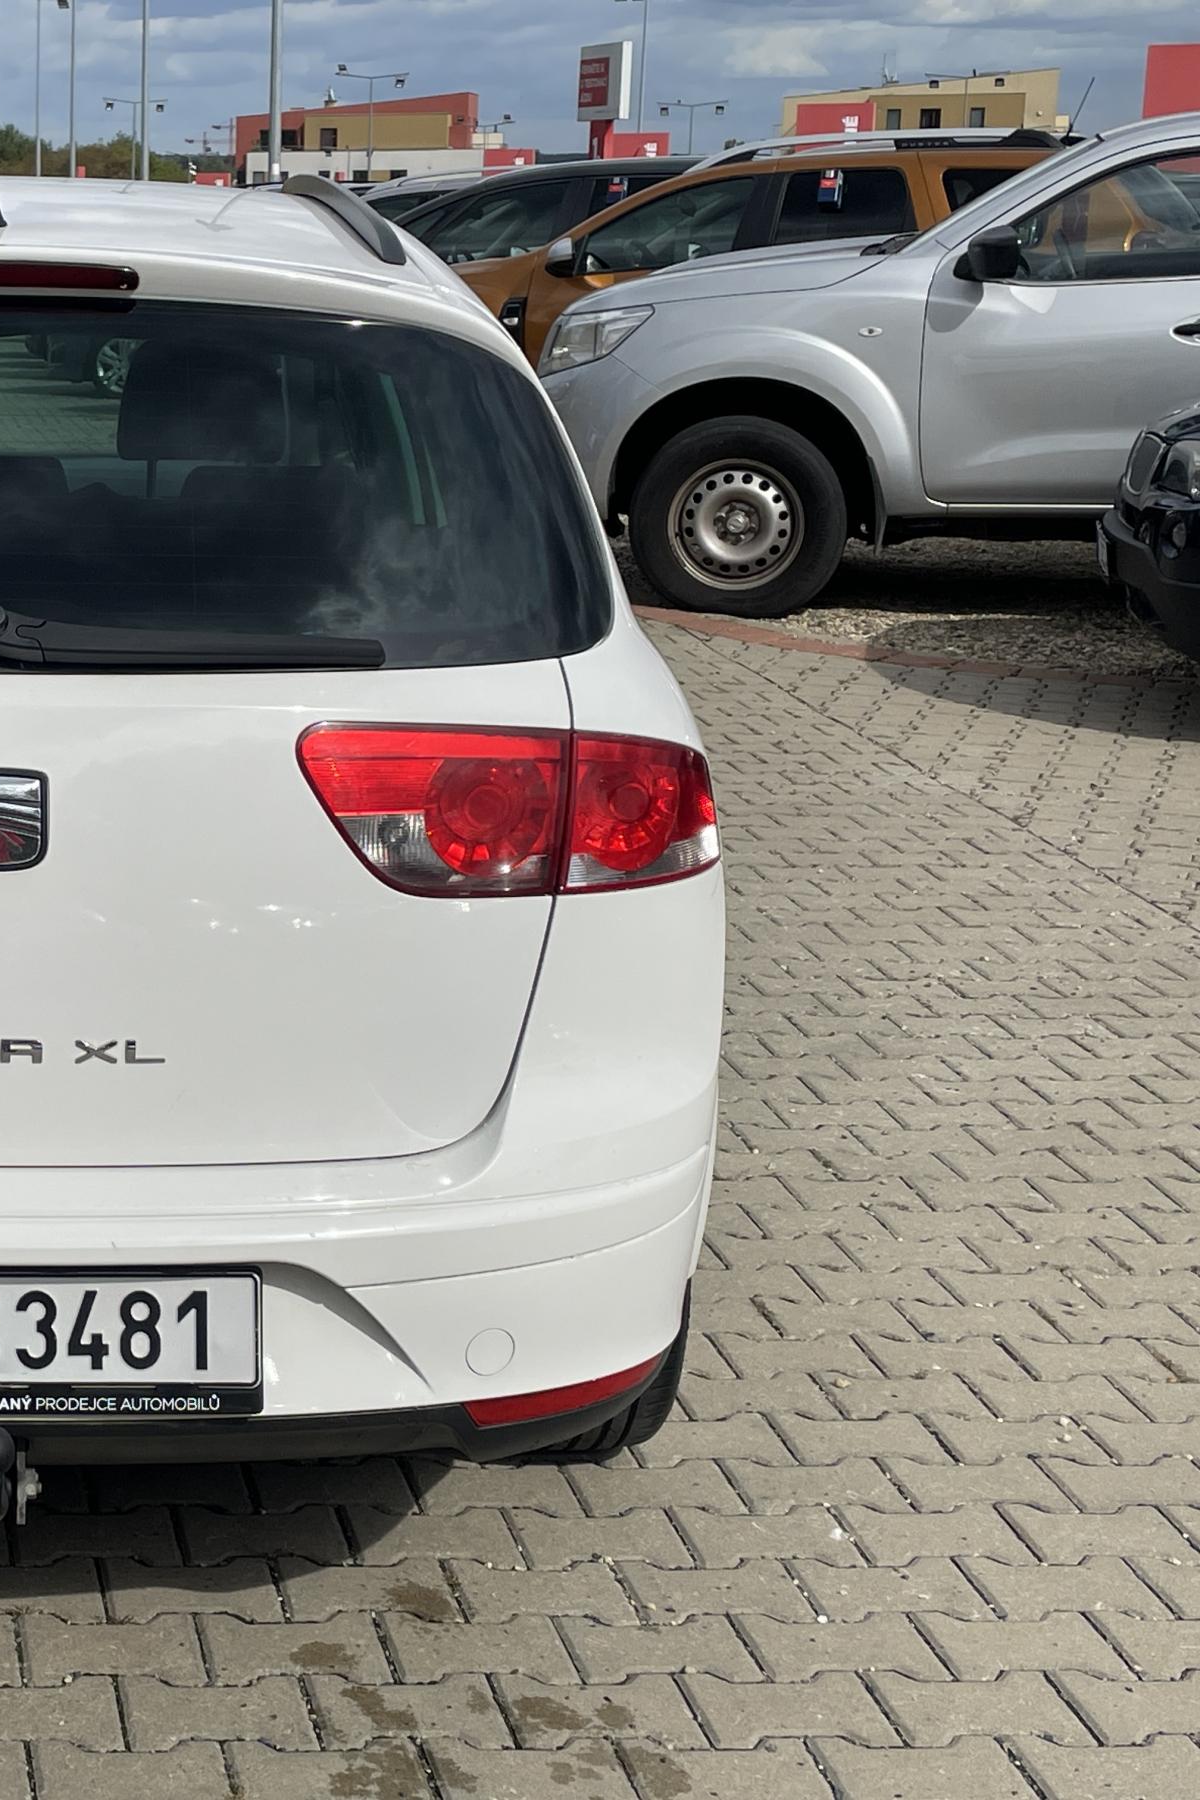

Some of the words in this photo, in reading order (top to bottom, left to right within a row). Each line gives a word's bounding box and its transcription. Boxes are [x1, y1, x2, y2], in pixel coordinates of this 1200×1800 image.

[74, 1039, 166, 1065] XL
[15, 1290, 208, 1370] 3481
[35, 1397, 117, 1411] PRODEJCE
[120, 1393, 221, 1411] AUTOMOBILŮ
